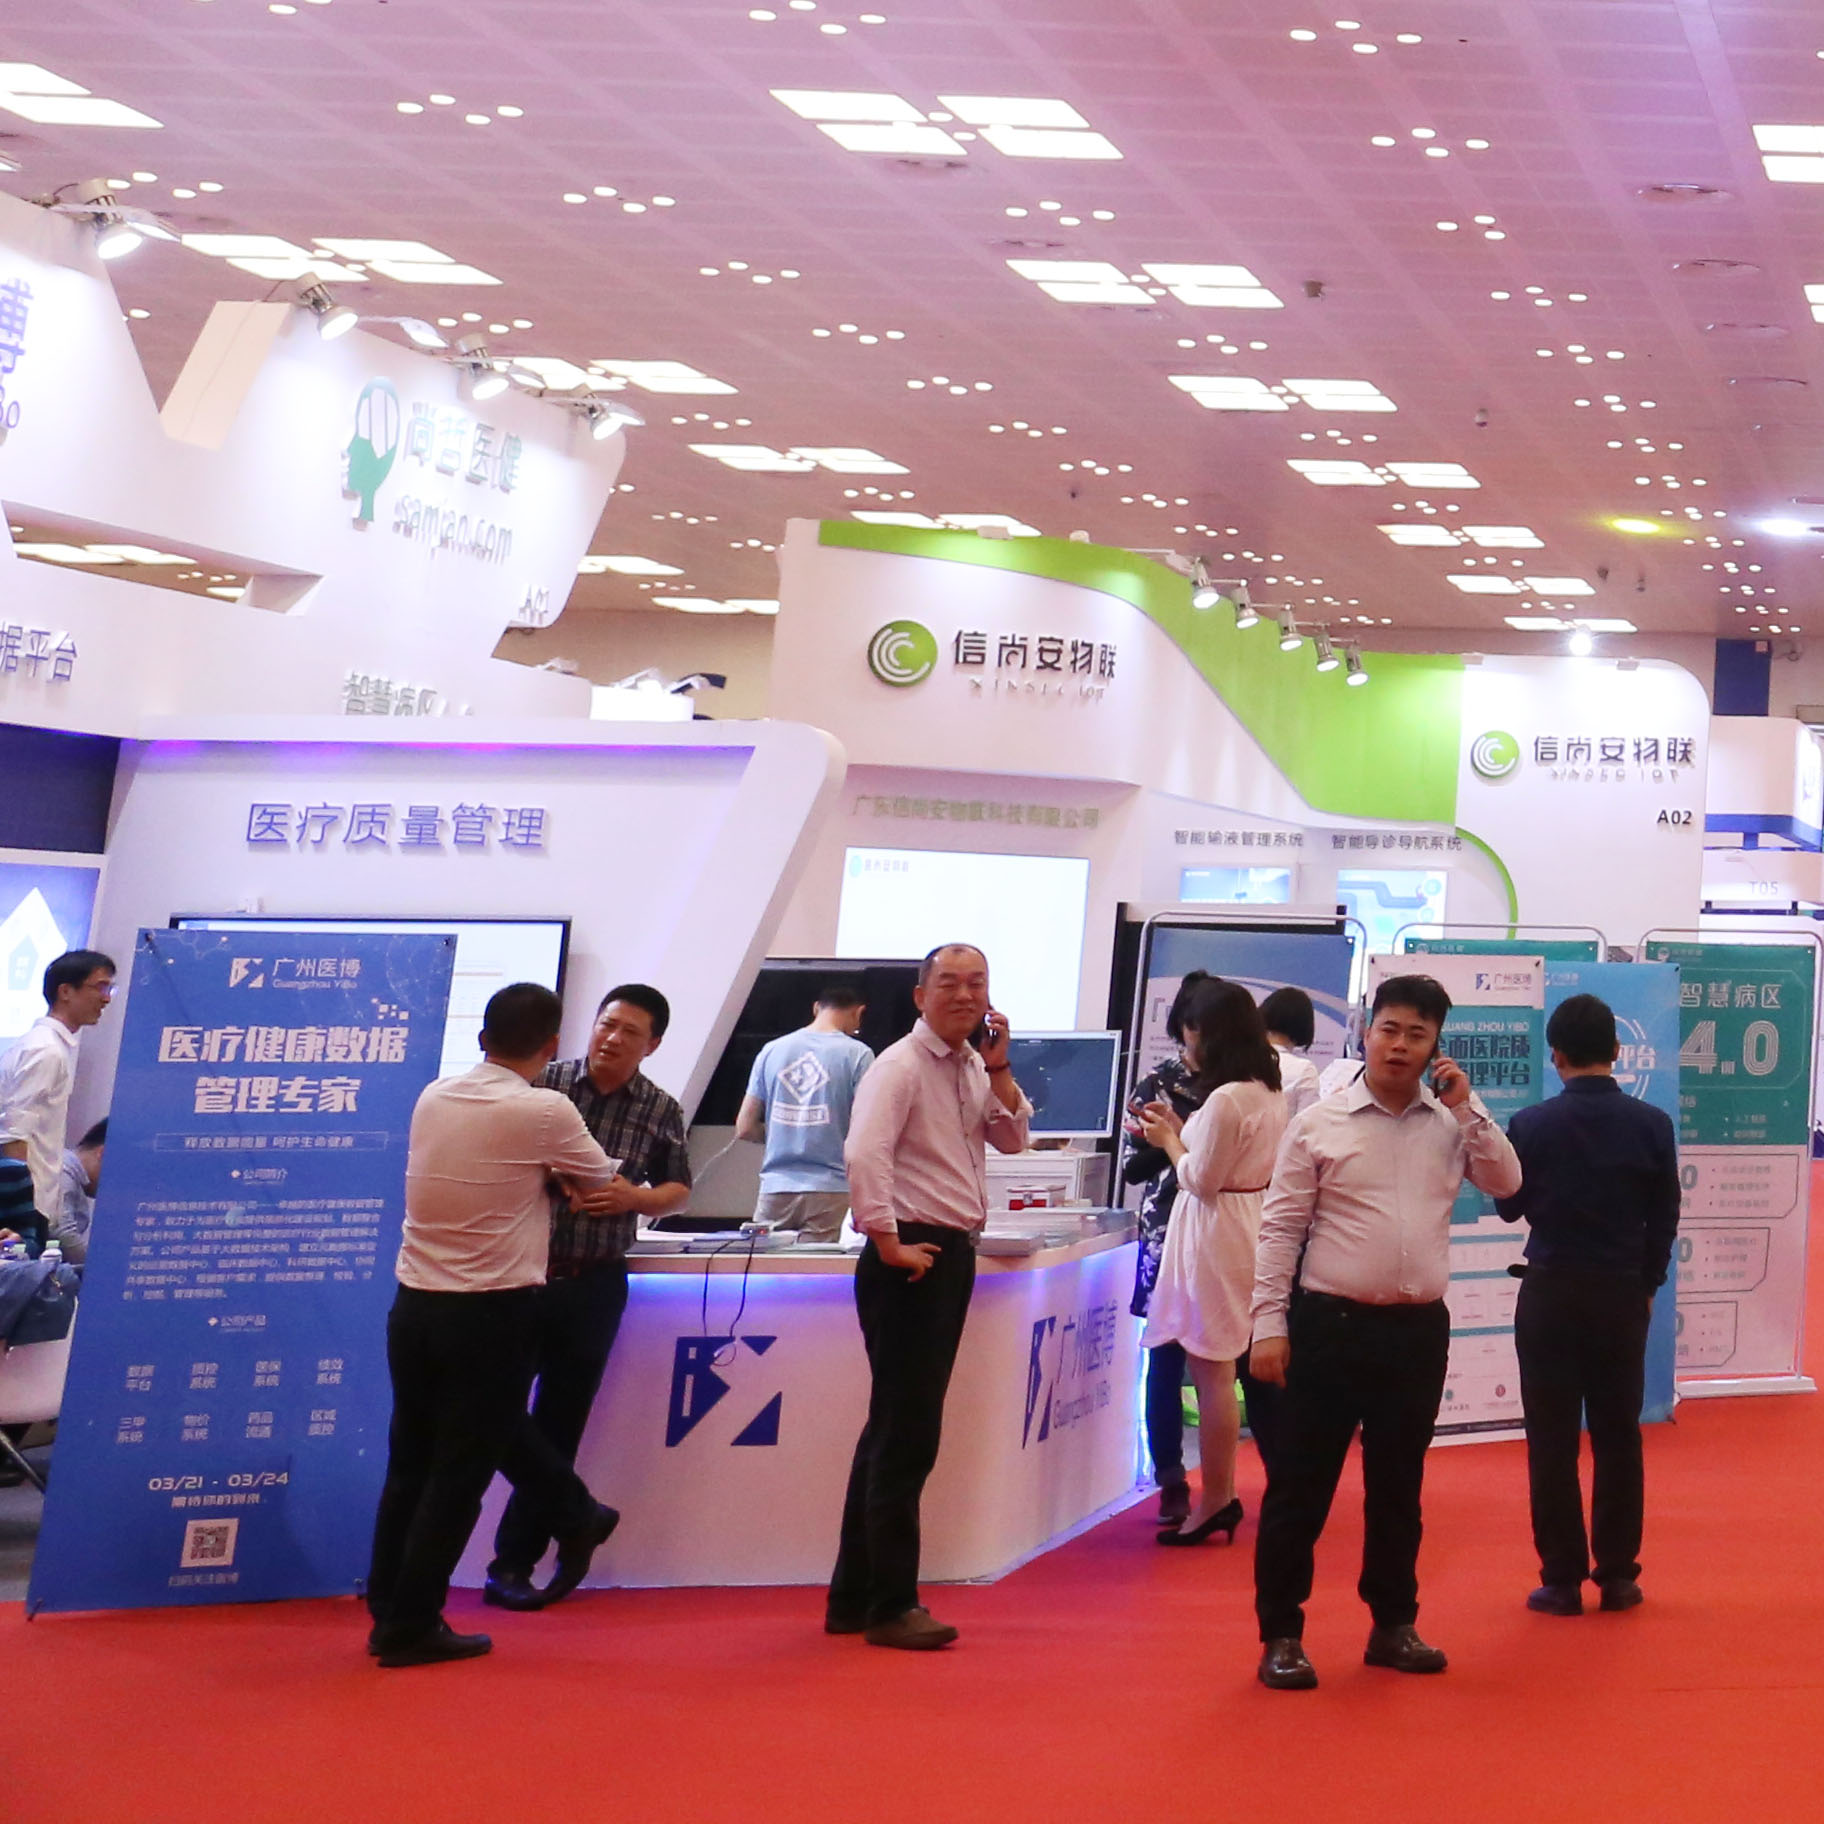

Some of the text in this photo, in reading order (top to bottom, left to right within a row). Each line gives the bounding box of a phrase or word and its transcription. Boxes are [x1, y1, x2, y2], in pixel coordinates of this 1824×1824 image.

[953, 630, 1117, 679] 信尚安物联
[1534, 736, 1696, 764] 信尚安物联
[853, 794, 1100, 829] 广东信尚安物联科技有限公司
[1657, 809, 1692, 826] A02
[246, 801, 546, 849] 医疗质量管理
[1174, 829, 1304, 848] 智能输液管理系统
[1331, 834, 1462, 852] 智能导诊导航系统
[1751, 880, 1779, 895] T05
[271, 957, 361, 978] 广州医博
[272, 979, 331, 990] Guangzhou
[1680, 982, 1784, 1010] 智慧病区
[158, 1025, 410, 1064] 医疗健康数据
[1680, 1020, 1780, 1076] 4.0
[194, 1075, 362, 1114] 管理专家
[273, 1133, 355, 1149] 呵护生命健康
[148, 1475, 204, 1491] 03/21
[227, 1472, 289, 1487] 03/24
